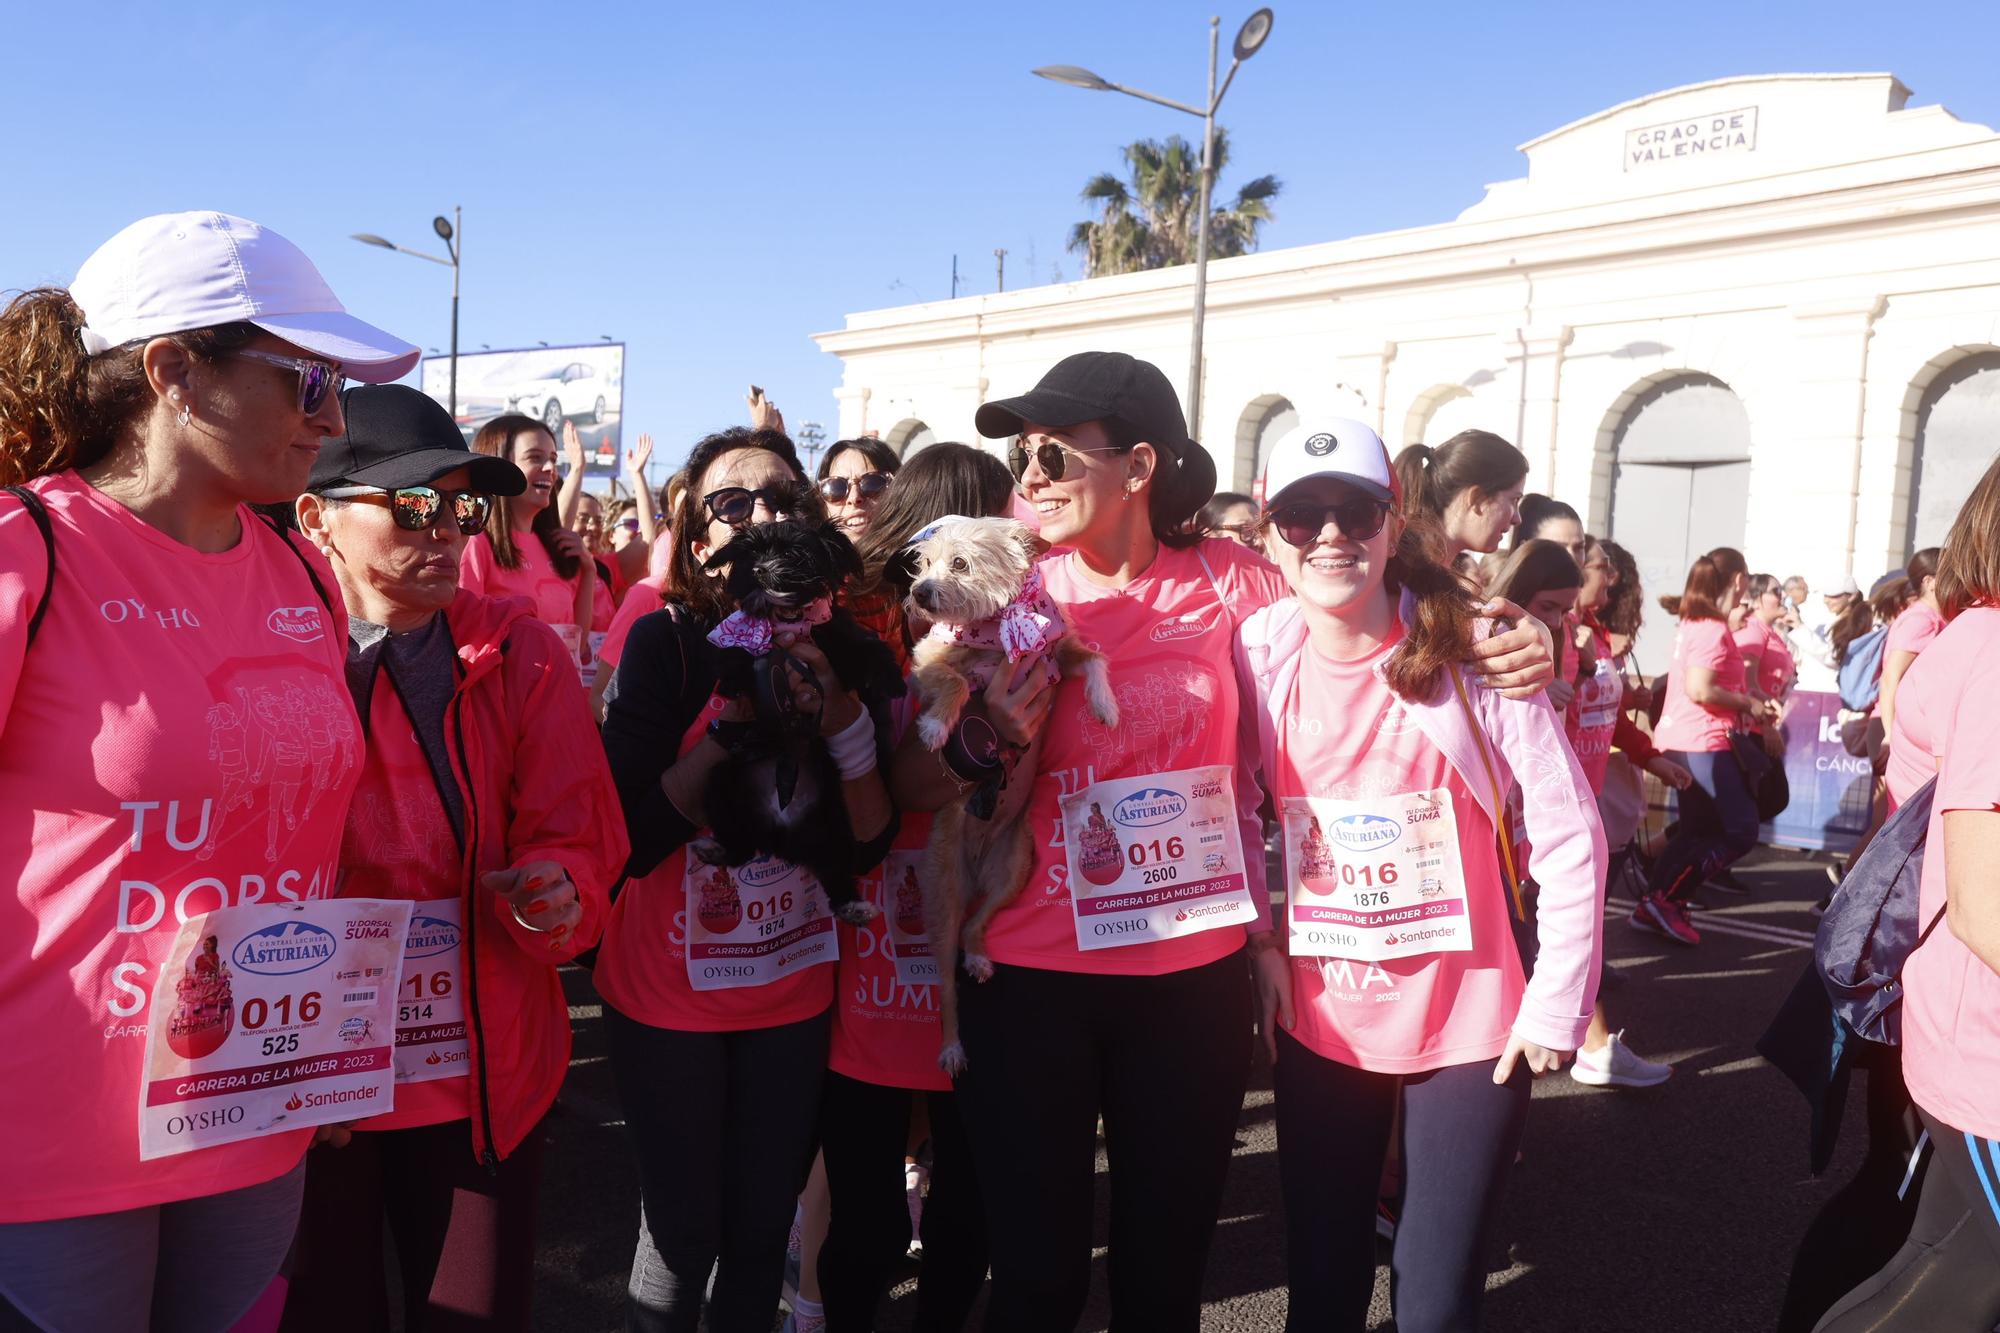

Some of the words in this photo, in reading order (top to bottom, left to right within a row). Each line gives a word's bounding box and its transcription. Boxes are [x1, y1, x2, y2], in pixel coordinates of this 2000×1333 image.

[1638, 124, 1698, 145] GRAO
[1712, 115, 1744, 132] DE
[1632, 132, 1746, 163] VALENCIA
[1288, 714, 1322, 736] SHO
[1816, 755, 1872, 774] CÁNC
[1192, 786, 1222, 799] SUMA
[1119, 802, 1182, 821] ASTURIANA
[1407, 811, 1441, 825] SUMA
[120, 799, 213, 852] TU
[1335, 827, 1396, 842] ASTURIANA
[1128, 836, 1185, 866] 016
[1143, 865, 1177, 885] 2600
[1342, 862, 1398, 886] 016
[1095, 896, 1144, 911] CARRERA
[1146, 893, 1160, 904] DE
[1161, 890, 1174, 900] LA
[1174, 884, 1207, 898] MUJER
[1209, 880, 1231, 892] 2023
[1353, 891, 1389, 906] 1876
[746, 891, 793, 921] 016
[1188, 901, 1240, 919] Santander
[1311, 909, 1354, 923] CARRERA
[1355, 915, 1367, 925] DE
[1369, 914, 1383, 925] LA
[1385, 909, 1421, 922] MUJER
[1425, 904, 1449, 916] 2023
[344, 927, 389, 940] SUMA
[358, 920, 392, 928] DORSAL
[758, 918, 785, 936] 1874
[1094, 918, 1149, 937] OYSHO
[259, 938, 293, 947] CENTRAL
[295, 935, 327, 944] LECHERA
[405, 934, 456, 949] URIANA
[1308, 931, 1357, 947] OYSHO
[1400, 927, 1456, 944] Santander
[240, 943, 329, 965] ASTURIANA
[707, 946, 754, 955] CARRERA
[756, 945, 769, 953] DE
[769, 941, 779, 950] LA
[787, 942, 826, 964] Santander
[704, 966, 755, 978] OYSHO
[910, 964, 937, 975] OYS
[1324, 959, 1394, 990] MA
[398, 971, 452, 1000] 16
[855, 974, 940, 1011] SUM
[1375, 992, 1401, 1002] 2023
[241, 991, 322, 1029] 016
[399, 1004, 433, 1021] 514
[103, 1024, 148, 1039] CARR
[412, 1030, 428, 1041] LA
[430, 1025, 467, 1038] MUJE
[262, 1033, 299, 1057] 525
[176, 1076, 247, 1097] CARRERA
[250, 1072, 273, 1085] DE
[273, 1068, 291, 1081] LA
[293, 1059, 338, 1077] MUJER
[343, 1054, 375, 1069] 2023
[305, 1085, 379, 1109] Santander
[167, 1105, 245, 1135] OYSHO
